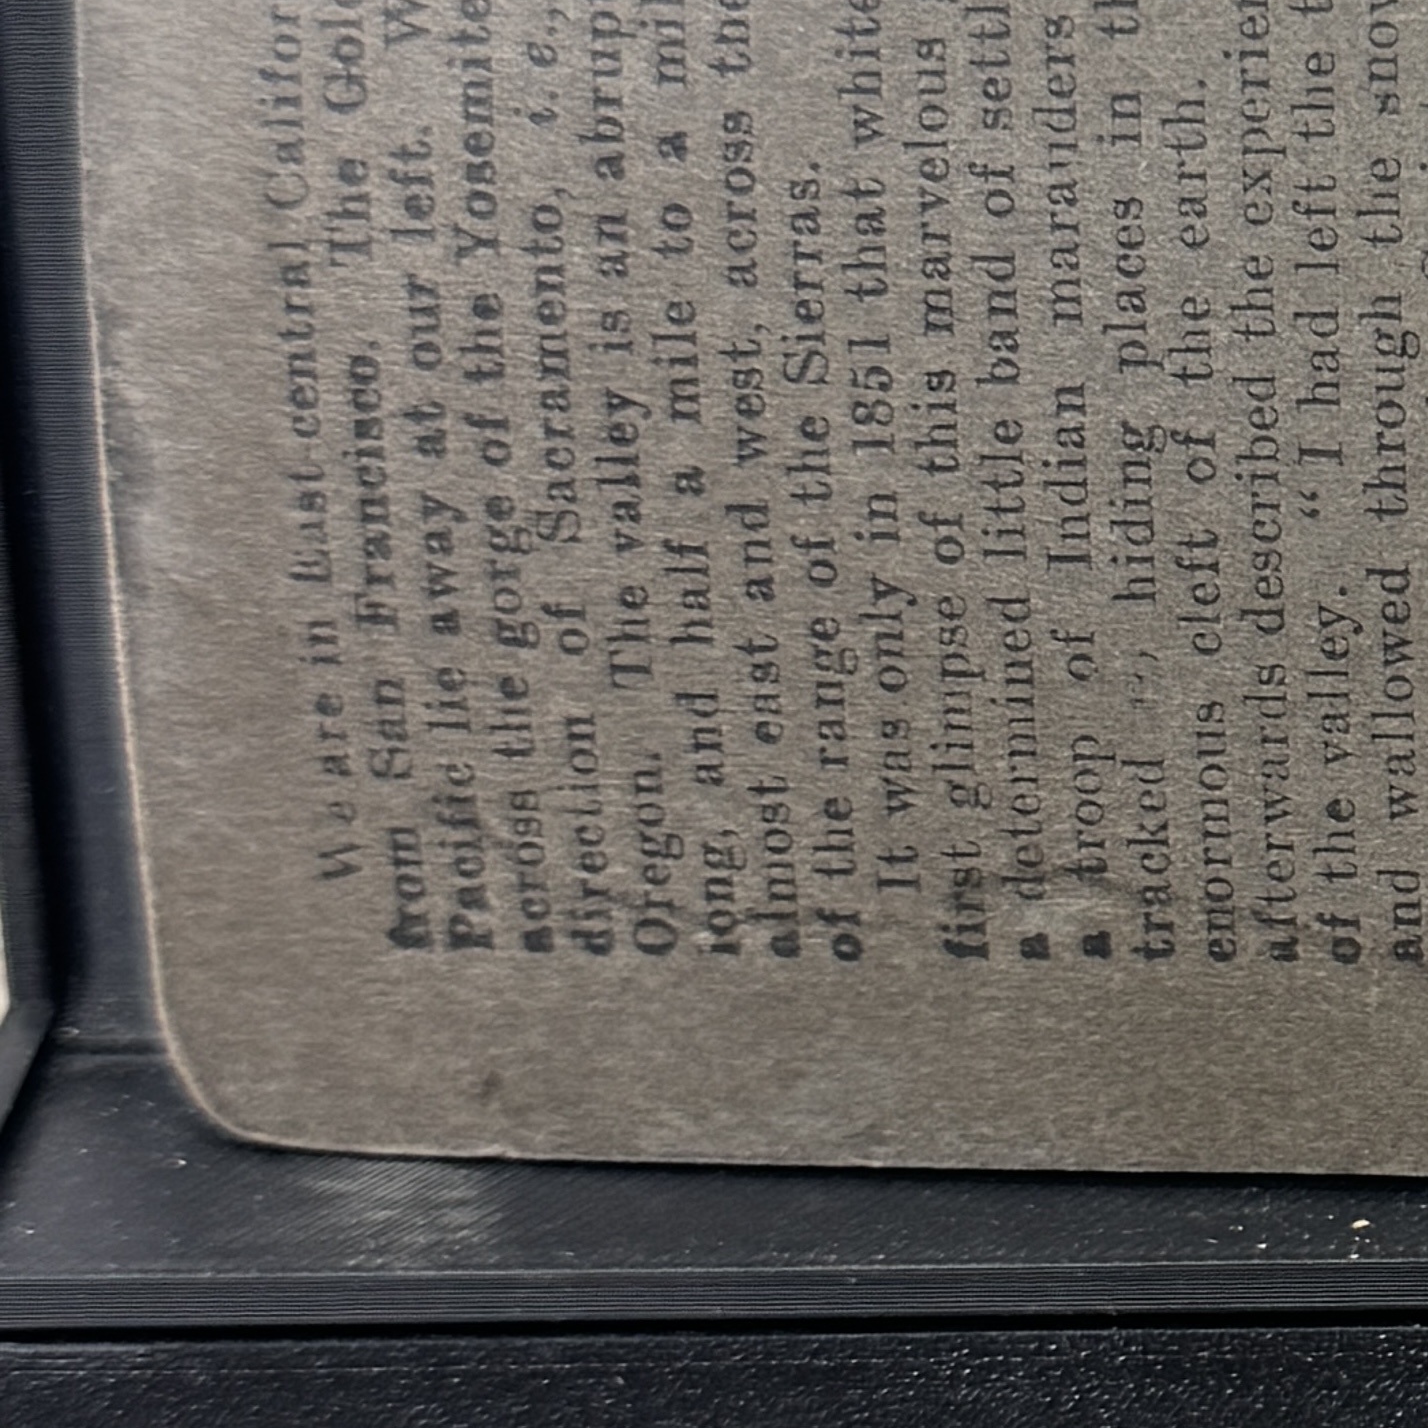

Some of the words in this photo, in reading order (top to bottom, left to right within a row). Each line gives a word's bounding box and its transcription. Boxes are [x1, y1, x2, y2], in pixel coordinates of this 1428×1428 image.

[380, 125, 438, 242] left.
[720, 109, 759, 290] across
[900, 36, 956, 337] marvelous
[1158, 78, 1211, 252] earth.
[1351, 156, 1405, 249] the
[836, 176, 890, 303] that
[402, 271, 443, 372] our
[1163, 295, 1220, 388] the
[389, 399, 448, 460] at
[716, 323, 771, 469] west,
[845, 333, 897, 455] 1851
[907, 368, 962, 477] this
[1356, 293, 1422, 522] through
[1171, 425, 1221, 486] of
[416, 490, 469, 636] away
[722, 501, 776, 603] and
[850, 490, 903, 544] in
[913, 508, 966, 566] of
[849, 571, 920, 695] only
[1171, 527, 1224, 657] cleft
[422, 666, 481, 734] lie
[732, 633, 785, 746] east
[928, 595, 993, 812] glimpse
[1364, 560, 1420, 823] wallowed
[878, 717, 922, 819] was
[428, 762, 497, 952] Pacific
[745, 774, 803, 960] almost
[870, 844, 923, 894] It
[1192, 699, 1242, 964] enormous
[934, 840, 991, 961] first
